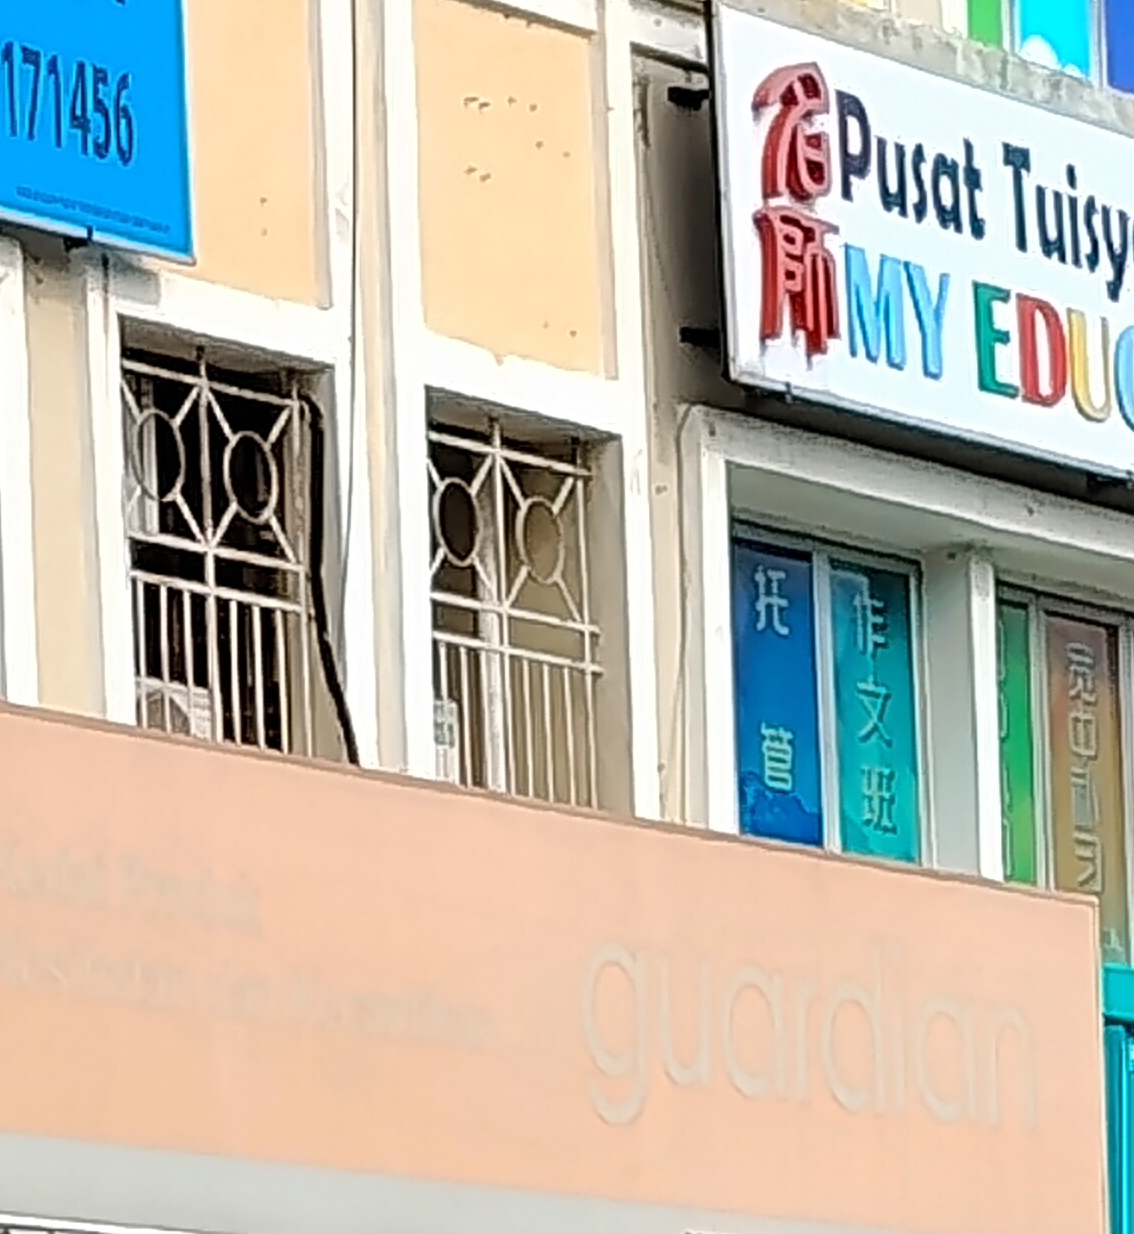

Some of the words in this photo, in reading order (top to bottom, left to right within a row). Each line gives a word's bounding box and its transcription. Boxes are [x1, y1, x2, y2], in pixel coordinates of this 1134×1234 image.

[835, 89, 985, 240] Pusat
[845, 243, 950, 380] MY
[582, 938, 1038, 1127] guardian
